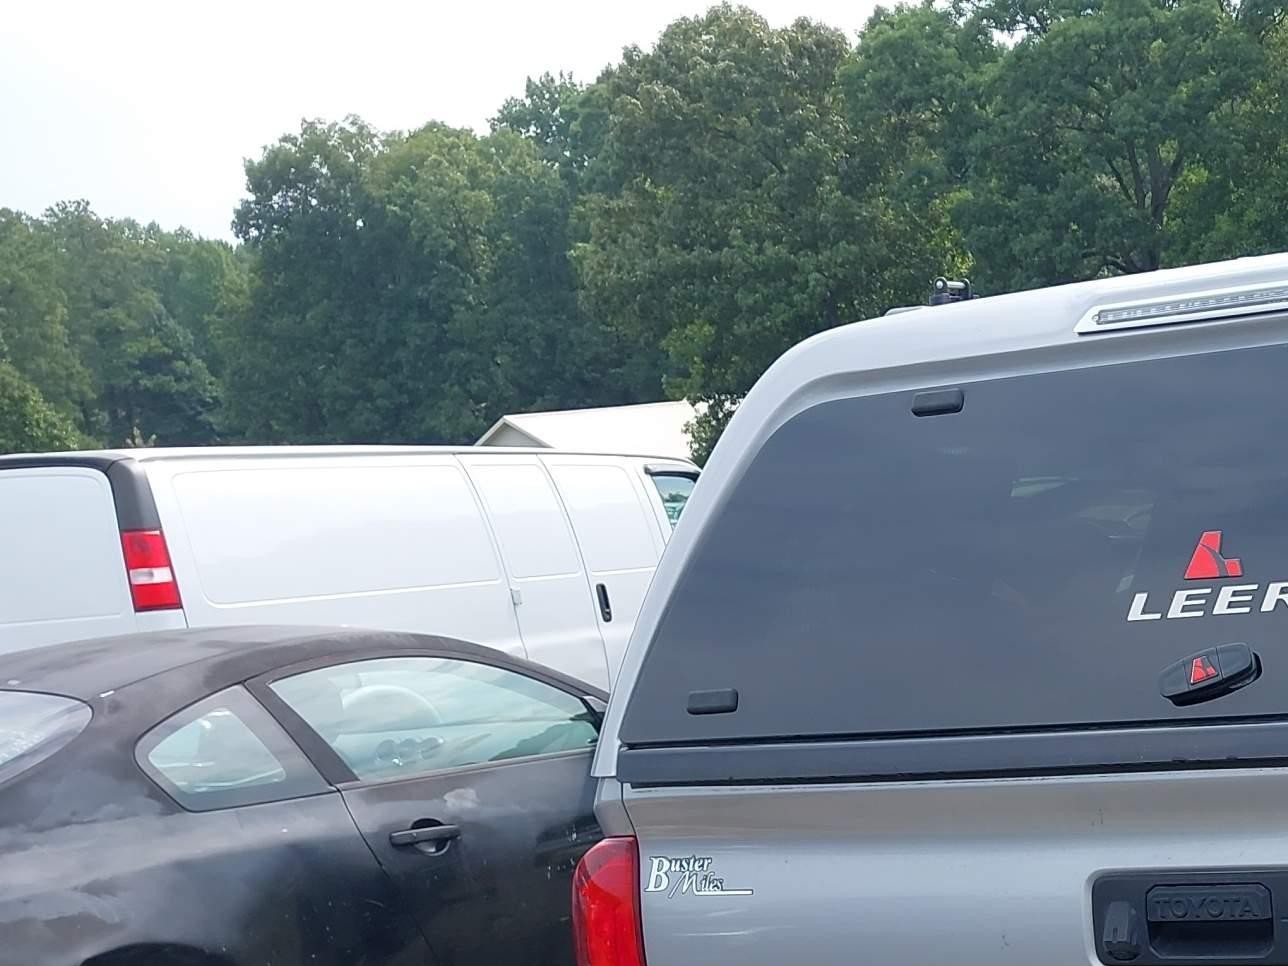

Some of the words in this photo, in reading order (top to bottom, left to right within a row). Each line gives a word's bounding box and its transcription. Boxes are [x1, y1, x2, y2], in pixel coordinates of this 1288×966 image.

[644, 855, 713, 892] Buster
[668, 871, 726, 898] Miles
[1154, 896, 1260, 919] TOYOTA
